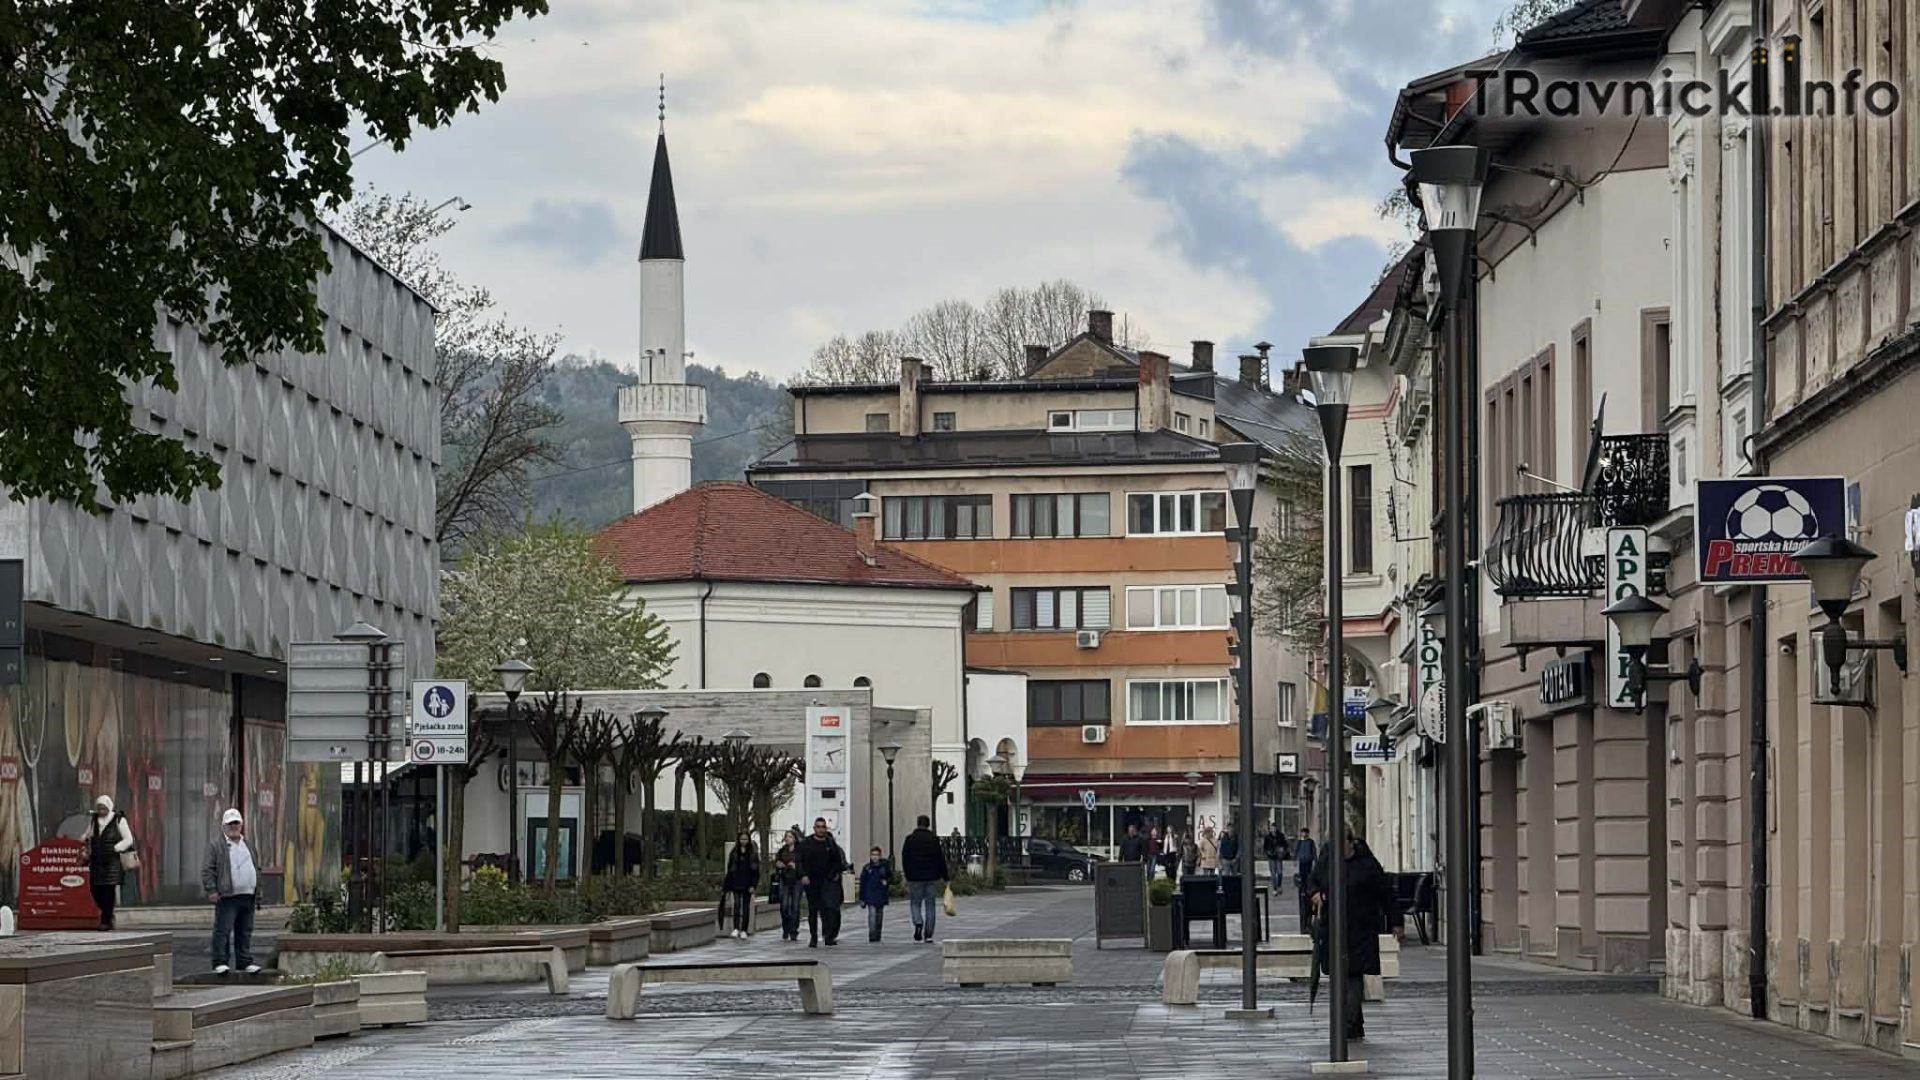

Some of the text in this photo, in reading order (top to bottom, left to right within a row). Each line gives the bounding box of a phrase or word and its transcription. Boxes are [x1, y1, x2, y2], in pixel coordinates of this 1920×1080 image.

[1736, 540, 1780, 553] sportska
[1704, 540, 1806, 577] PREMI
[1540, 663, 1574, 704] APOTEKA
[415, 722, 445, 731] Pješačka
[32, 865, 90, 873] otpadna oprem
